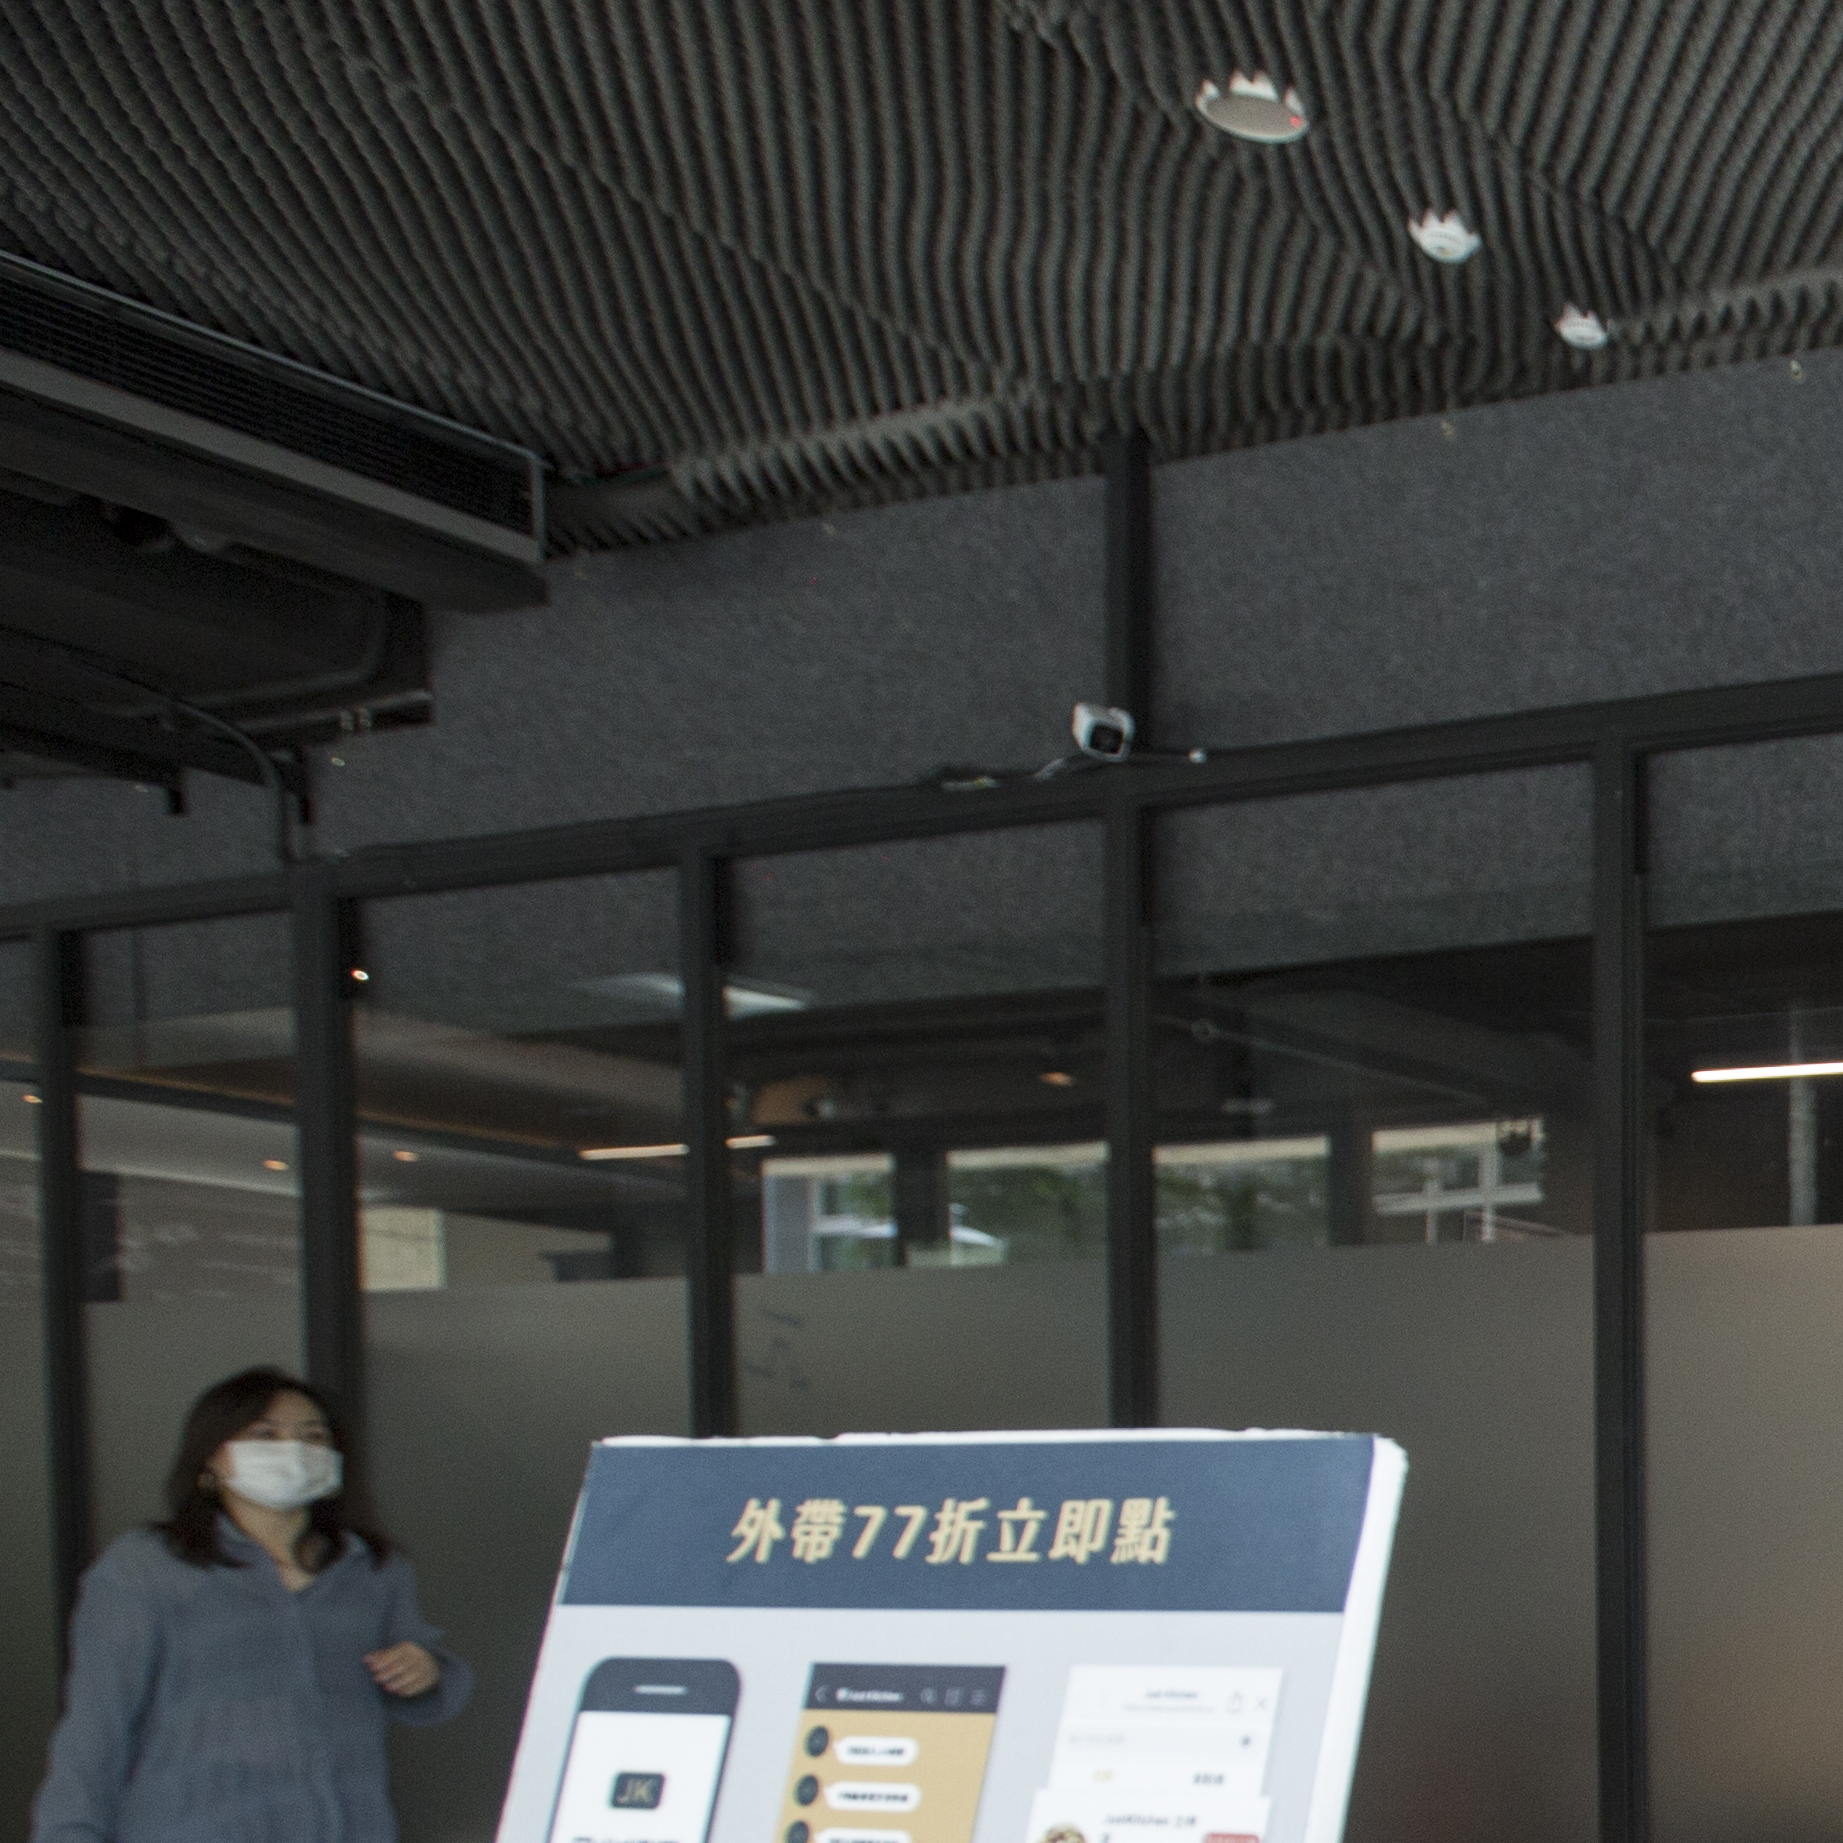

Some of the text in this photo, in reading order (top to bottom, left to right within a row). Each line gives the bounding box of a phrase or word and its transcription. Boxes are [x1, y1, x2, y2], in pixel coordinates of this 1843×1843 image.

[727, 1496, 1176, 1568] 外帶77折立即點
